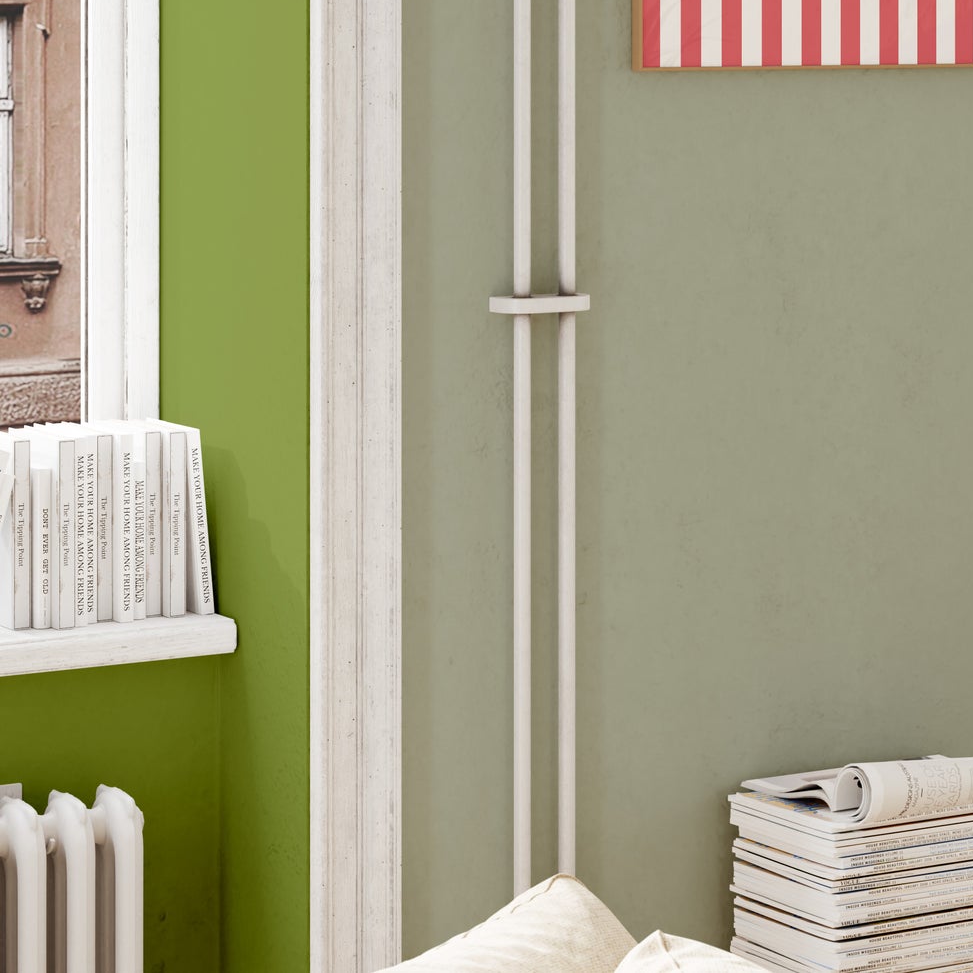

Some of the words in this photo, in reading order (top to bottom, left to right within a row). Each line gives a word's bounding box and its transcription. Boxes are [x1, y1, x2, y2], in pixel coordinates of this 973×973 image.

[191, 448, 199, 473] MAKE
[135, 480, 144, 501] MAKE
[194, 474, 202, 500] YOUR
[135, 502, 144, 522] YOUR
[196, 501, 204, 528] HOME
[135, 523, 144, 544] HOME
[135, 545, 144, 572] AMONG
[198, 530, 207, 565] AMONG
[135, 573, 144, 603] FRIENDS
[202, 566, 210, 604] FRIENDS
